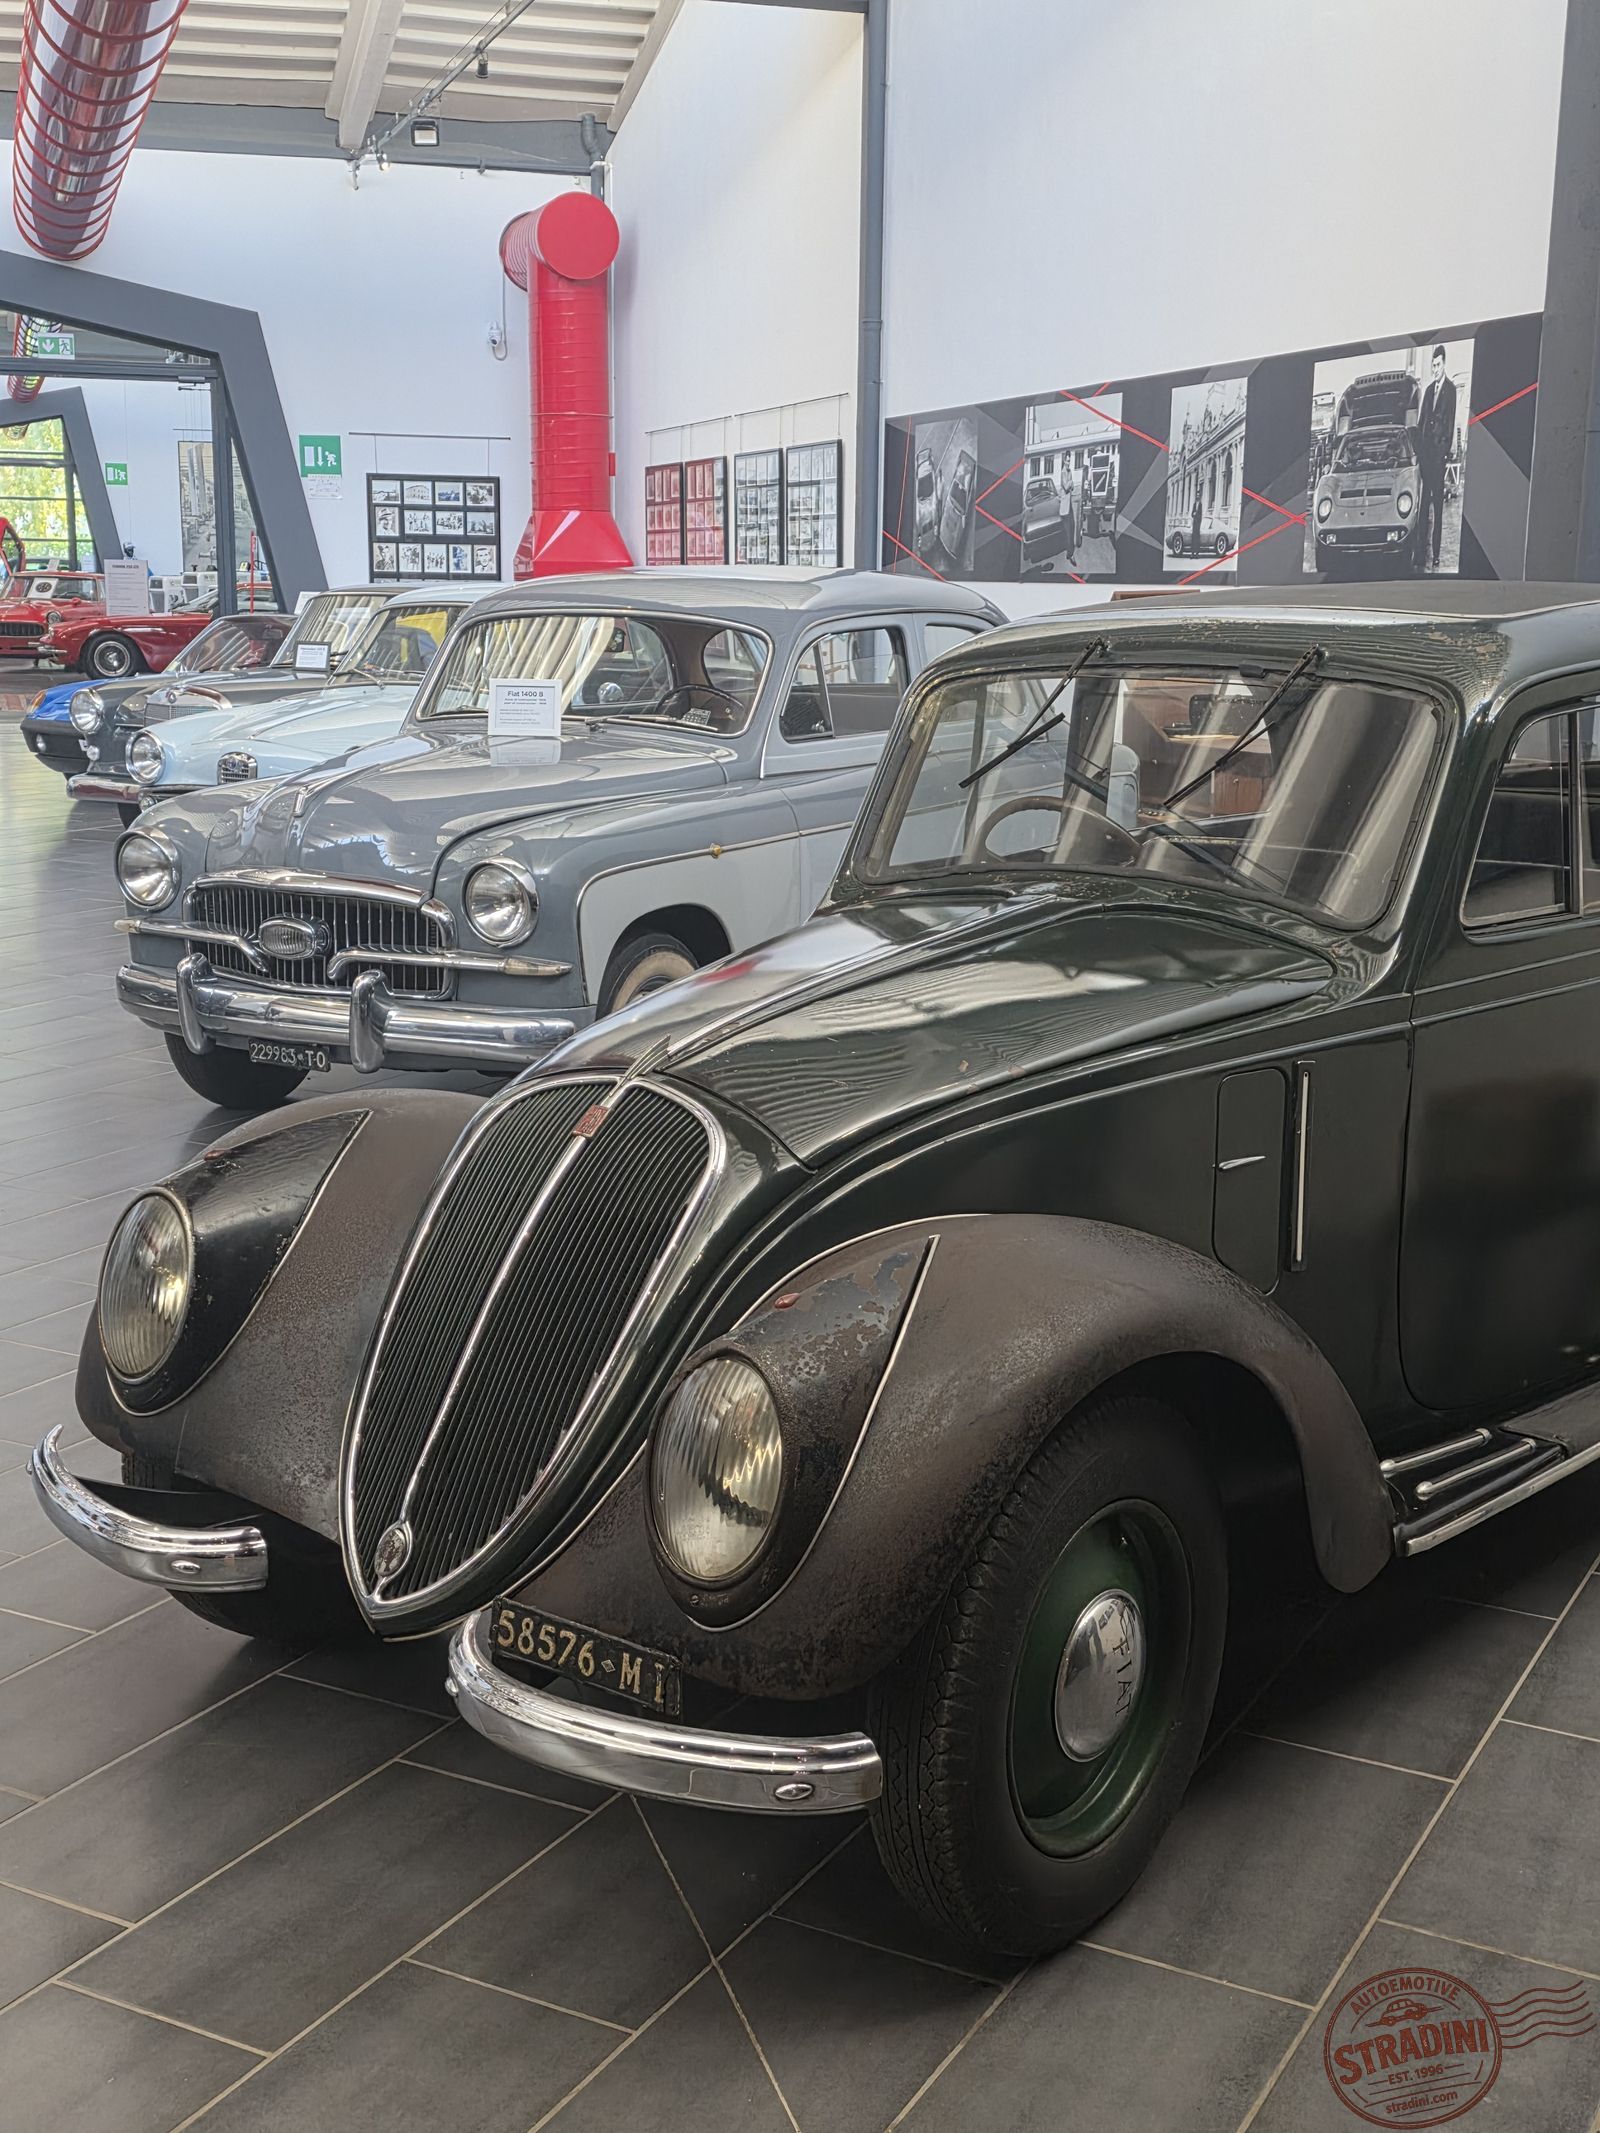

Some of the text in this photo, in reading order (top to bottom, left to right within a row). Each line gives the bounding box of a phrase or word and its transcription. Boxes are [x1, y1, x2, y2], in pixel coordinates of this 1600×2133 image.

[250, 1042, 297, 1065] 229983
[495, 1610, 595, 1677] 58576
[1111, 1637, 1133, 1717] FIAT
